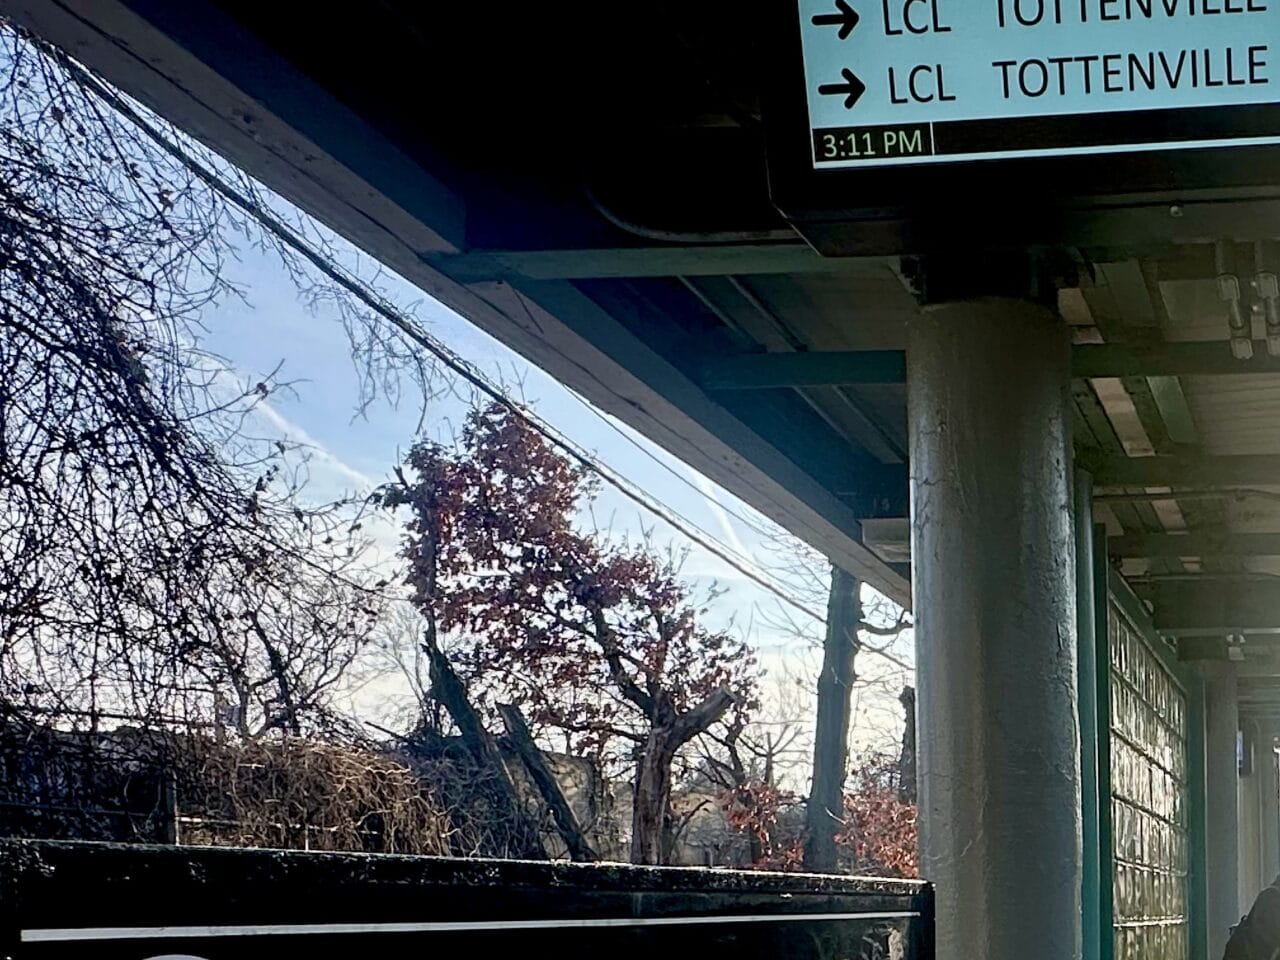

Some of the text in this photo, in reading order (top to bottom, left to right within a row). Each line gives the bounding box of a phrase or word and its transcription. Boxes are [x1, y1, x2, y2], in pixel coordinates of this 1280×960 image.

[882, 0, 952, 36] LCL
[888, 63, 957, 105] LCL
[991, 45, 1269, 99] TOTTENVILLE
[823, 129, 922, 158] 3:11 PM
